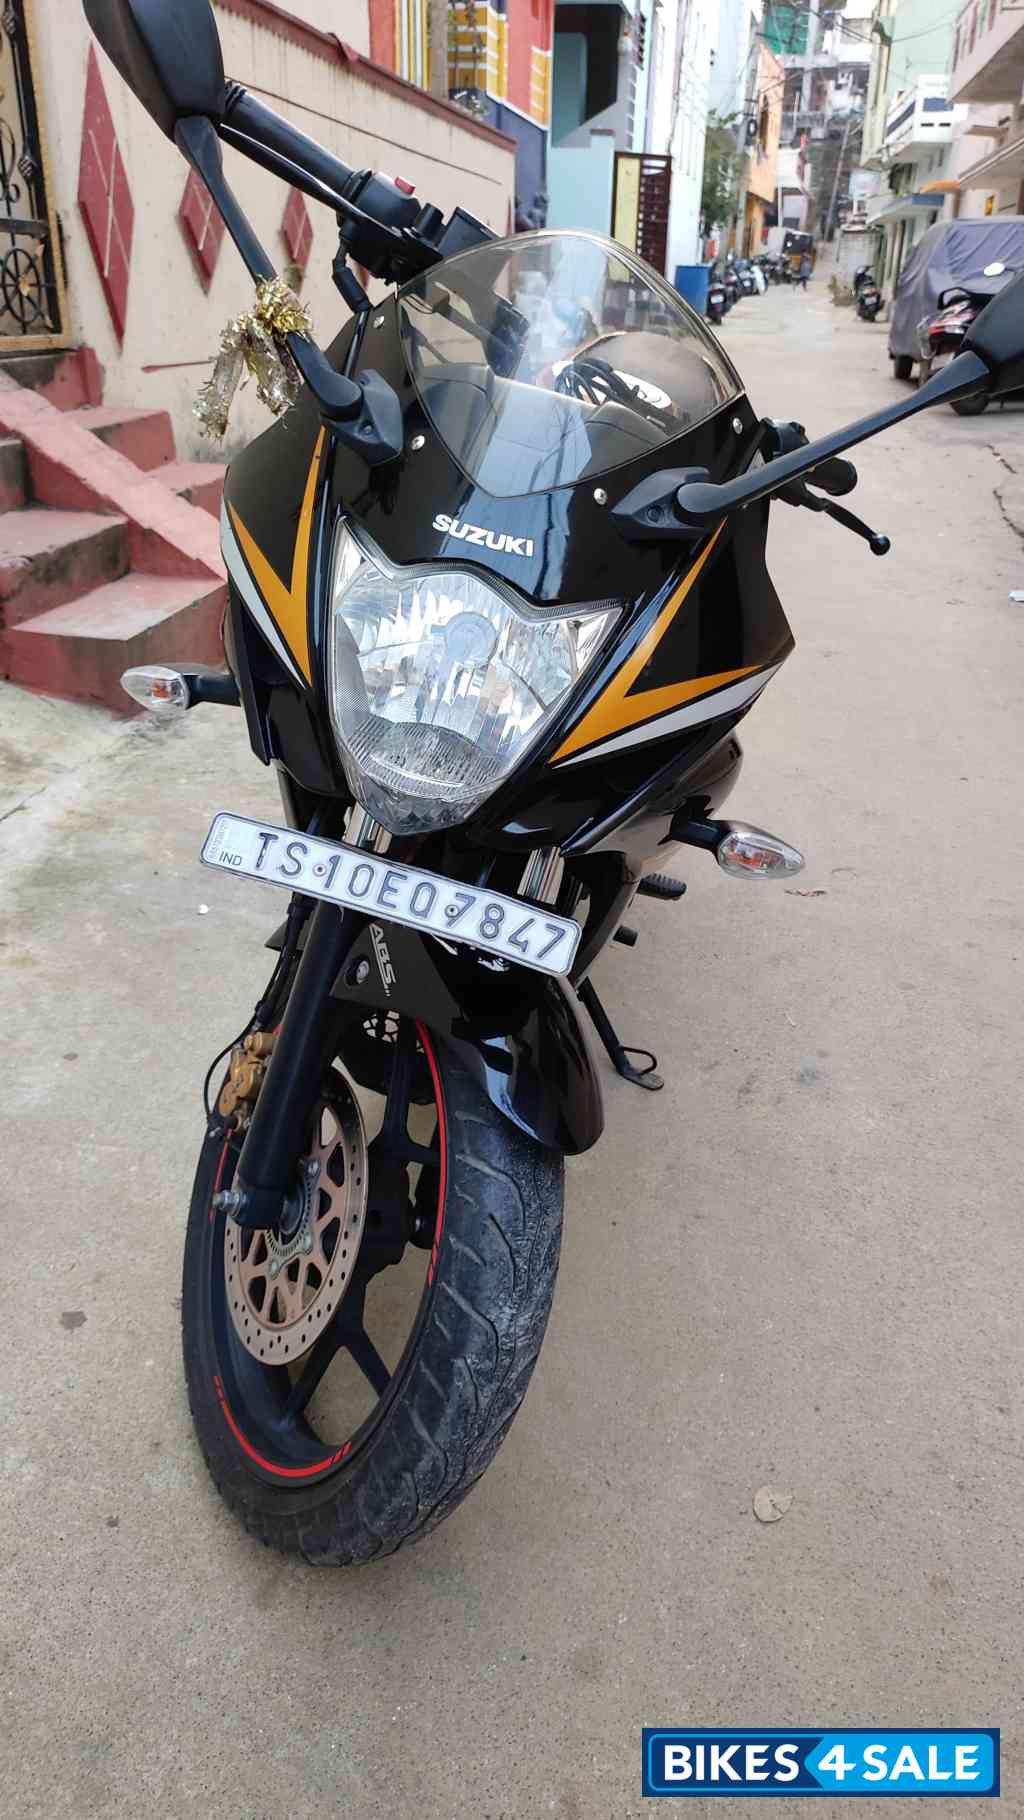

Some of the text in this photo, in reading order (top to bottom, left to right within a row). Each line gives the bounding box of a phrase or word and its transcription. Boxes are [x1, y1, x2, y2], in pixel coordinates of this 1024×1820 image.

[432, 514, 534, 557] SUZUKI
[219, 851, 242, 866] IND
[369, 923, 397, 988] ABS
